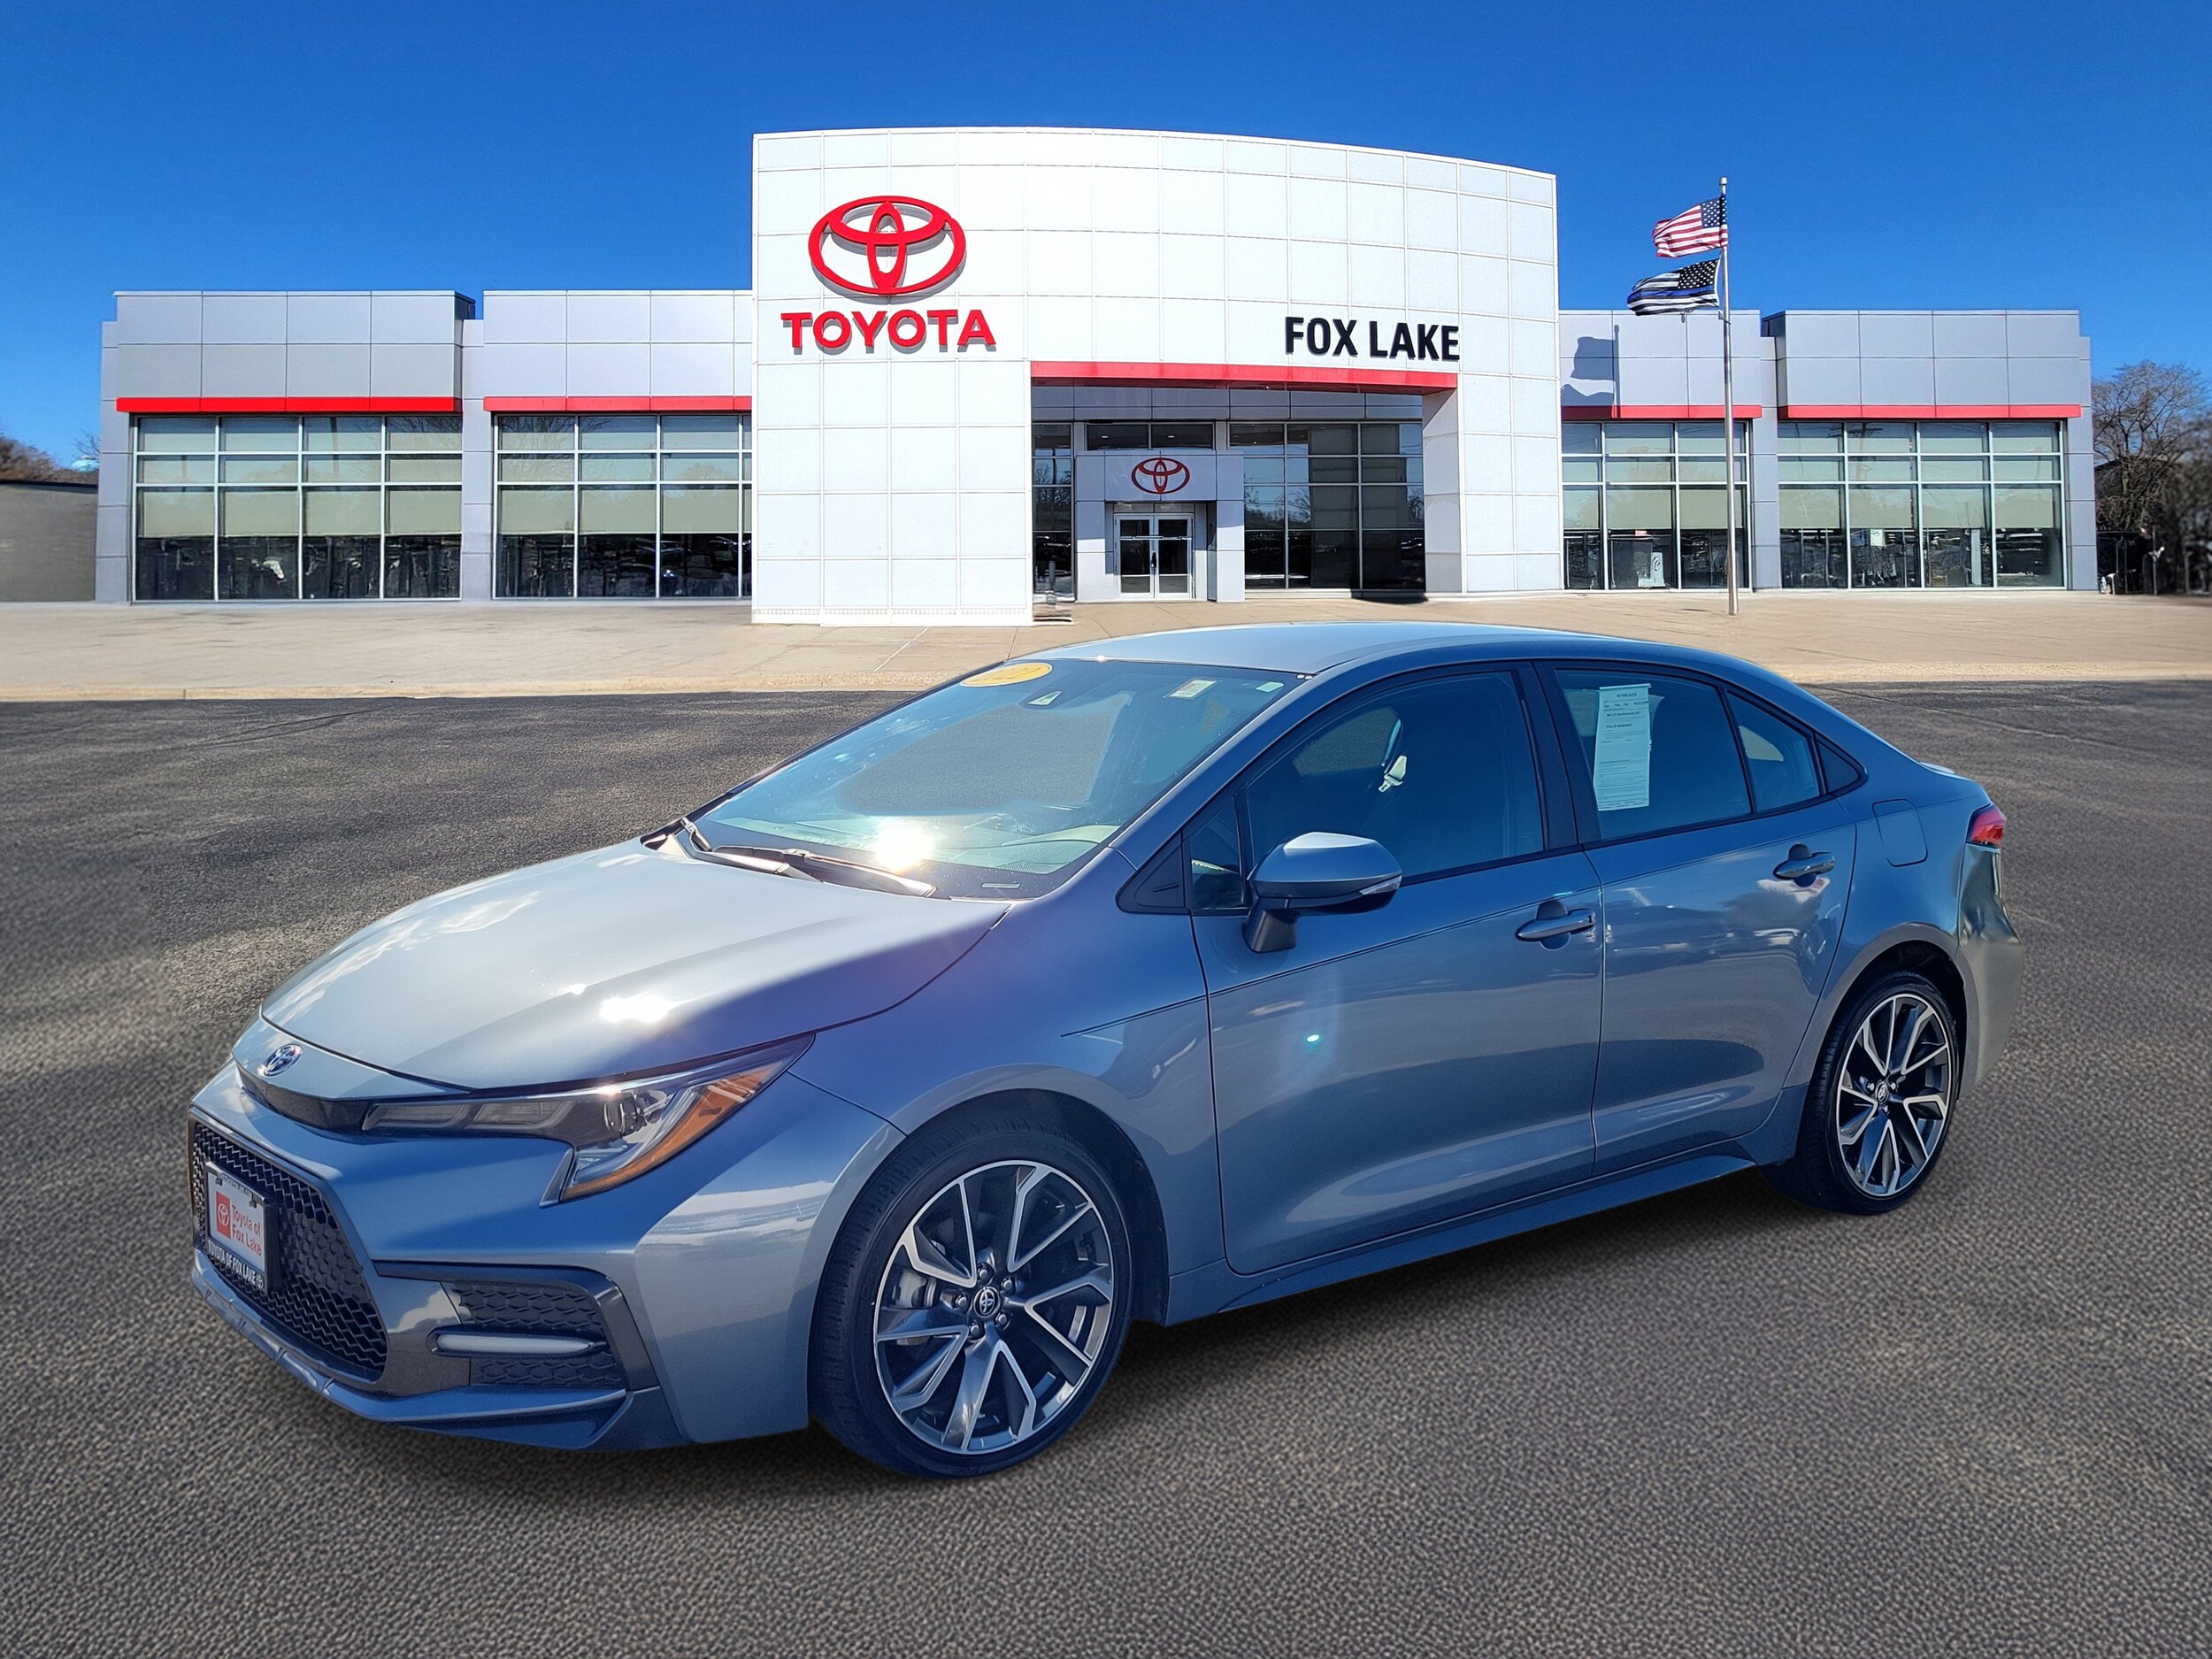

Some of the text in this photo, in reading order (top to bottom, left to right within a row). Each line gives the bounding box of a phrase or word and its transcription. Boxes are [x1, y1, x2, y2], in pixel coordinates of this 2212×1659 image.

[780, 309, 996, 349] TOYOTA
[1286, 316, 1460, 362] FOX LAKE
[232, 1204, 261, 1237] Toyota of
[232, 1224, 262, 1256] Fox Lake
[208, 1240, 226, 1263] TOYOTA
[233, 1257, 242, 1276] FOX
[242, 1264, 256, 1283] LAKE
